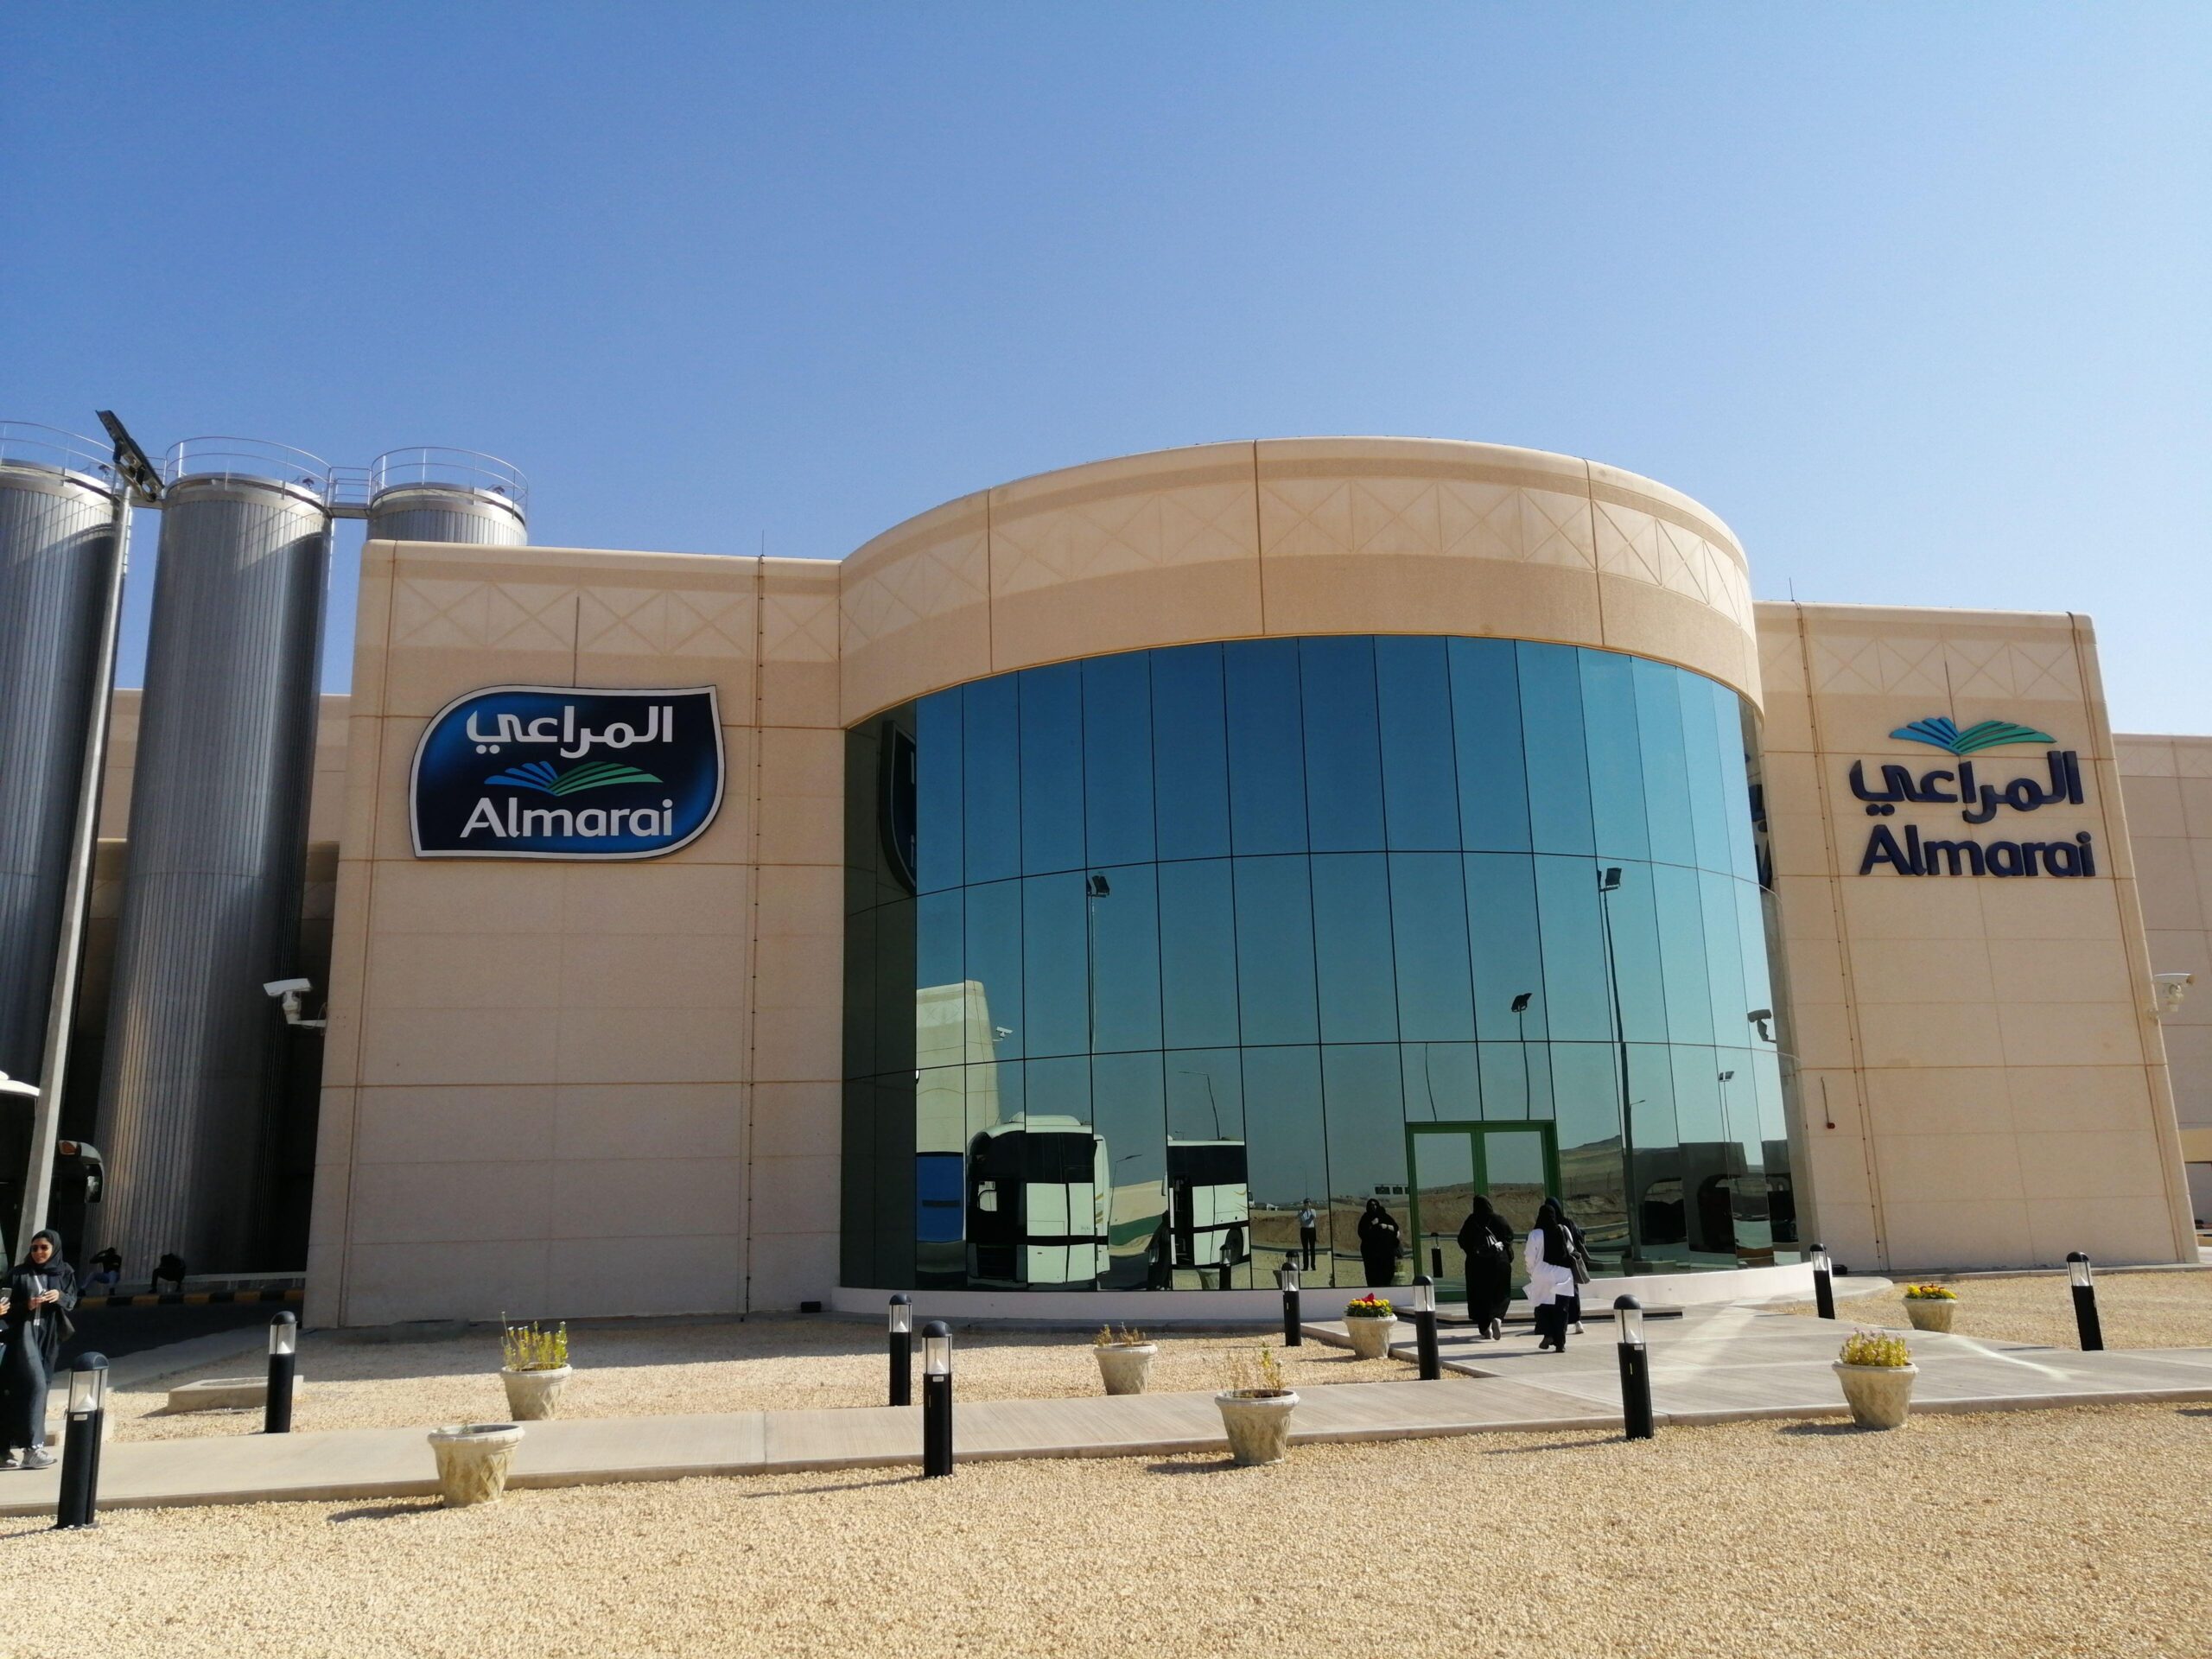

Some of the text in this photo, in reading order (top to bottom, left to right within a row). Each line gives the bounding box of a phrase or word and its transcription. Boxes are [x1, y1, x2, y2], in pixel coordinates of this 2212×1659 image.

[466, 705, 673, 759] المراعي
[1849, 751, 2083, 824] المراعي
[460, 797, 673, 838] Almarai
[1859, 824, 2096, 877] Almarai
